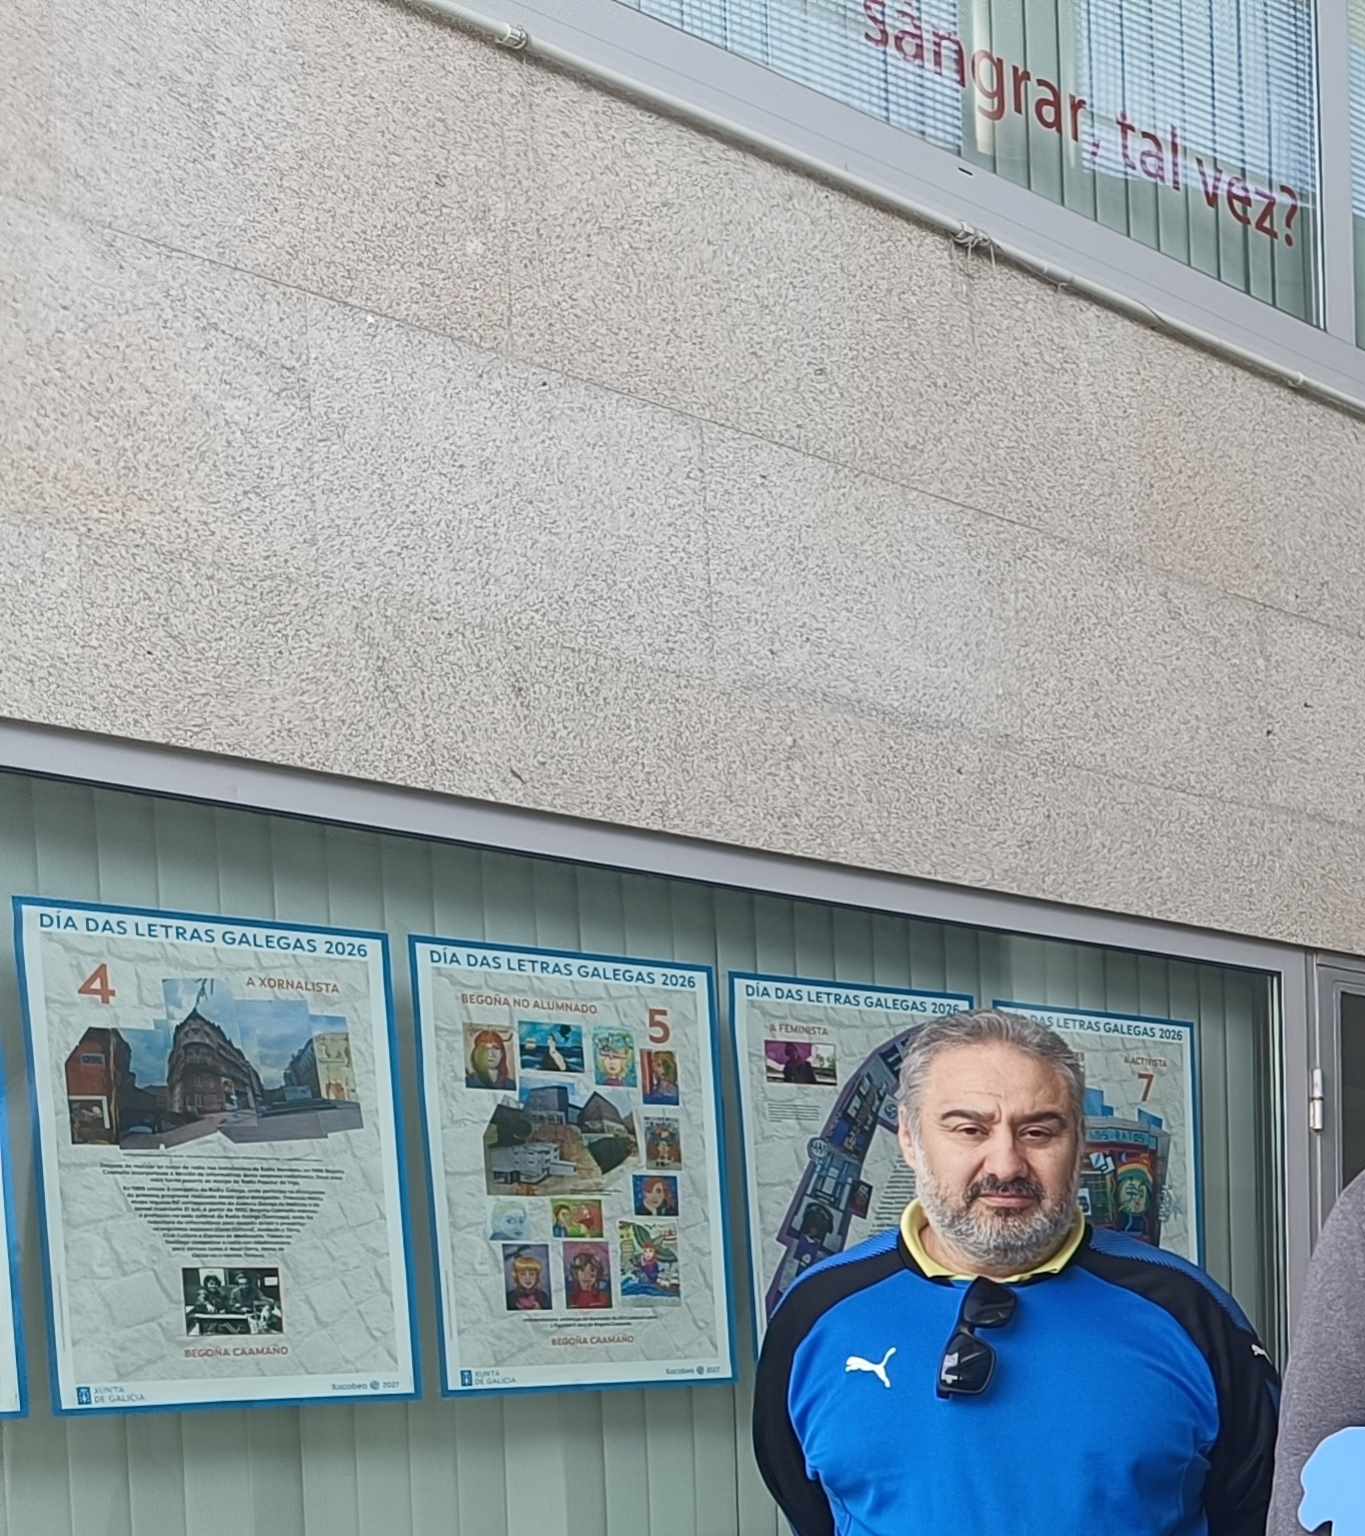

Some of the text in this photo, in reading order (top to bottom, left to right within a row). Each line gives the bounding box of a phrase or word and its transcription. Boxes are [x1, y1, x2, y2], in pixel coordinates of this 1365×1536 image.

[1116, 110, 1181, 191] tal
[1196, 156, 1299, 247] vez?
[39, 910, 368, 958] DÍA DAS LETRAS GALEGAS 2026
[77, 962, 117, 1005] 4
[429, 947, 697, 989] DÍA DAS LETRAS GALEGAS 2026
[246, 976, 341, 995] A XORNALISTA
[745, 982, 960, 1015] DÍA DAS LETRAS GALEGAS 2026
[461, 991, 598, 1015] BEGOÑA NO ALUMNADO
[648, 1007, 671, 1045] 5
[778, 1023, 829, 1037] FEMINISTA
[1056, 1014, 1101, 1033] LETRAS
[1102, 1021, 1157, 1039] GALEGAS
[1158, 1027, 1184, 1042] 2026
[1137, 1071, 1154, 1103] 7
